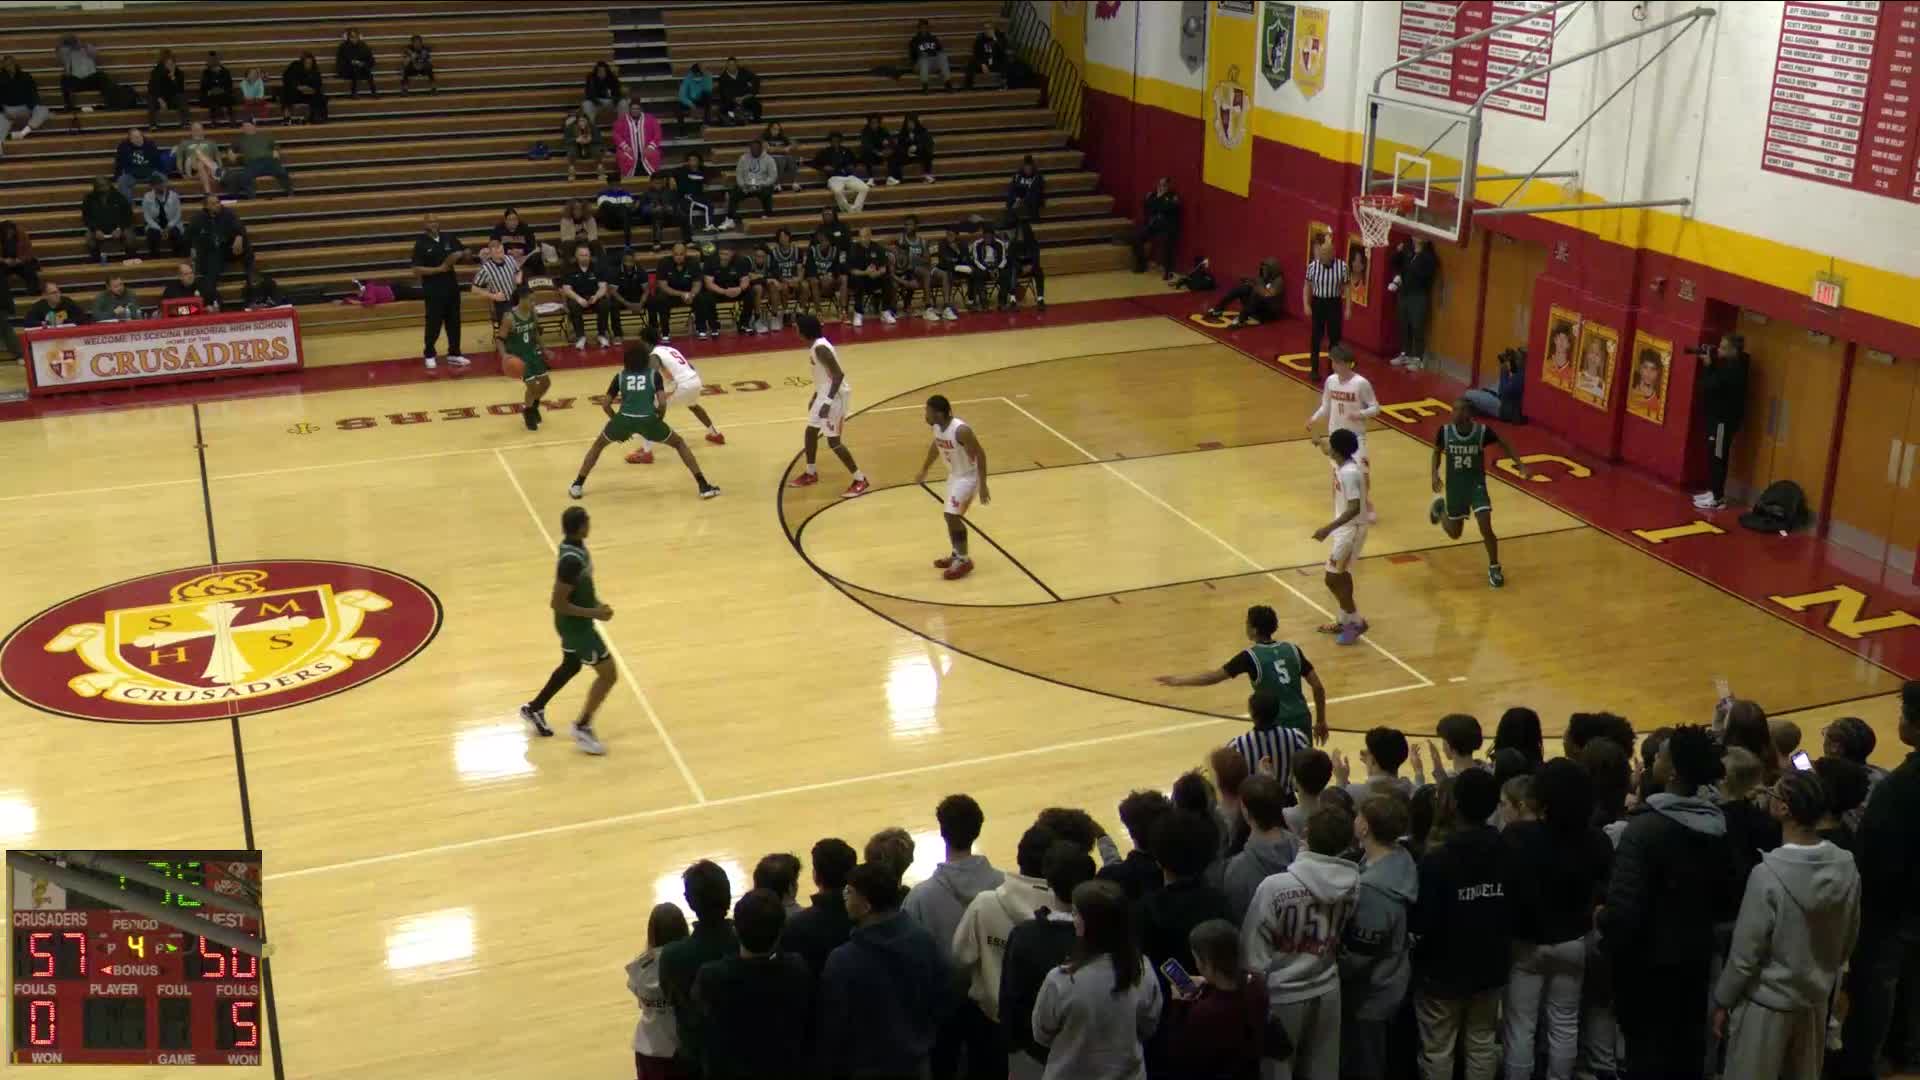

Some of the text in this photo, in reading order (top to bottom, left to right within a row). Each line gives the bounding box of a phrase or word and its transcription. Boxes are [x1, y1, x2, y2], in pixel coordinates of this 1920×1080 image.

[130, 334, 142, 342] TO
[253, 320, 289, 330] SCHOOL
[90, 336, 290, 378] CRUSADERS
[626, 375, 647, 391] 22
[1454, 457, 1473, 469] 24
[148, 598, 304, 630] S M
[148, 633, 294, 666] H S
[1273, 659, 1291, 684] 5
[123, 661, 333, 703] CRUSADERS
[13, 912, 88, 926] CRUSADERS
[128, 935, 144, 958] 4
[30, 933, 85, 977] 57
[114, 965, 158, 976] BONUS
[14, 984, 56, 995] FOULS
[90, 984, 138, 995] PLAYER
[157, 985, 191, 995] FOUL
[216, 985, 258, 996] FOULS
[31, 1001, 56, 1044] 0
[232, 1002, 256, 1047] 5
[32, 1053, 63, 1063] WON
[158, 1054, 195, 1065] GAME
[228, 1054, 258, 1065] WON
